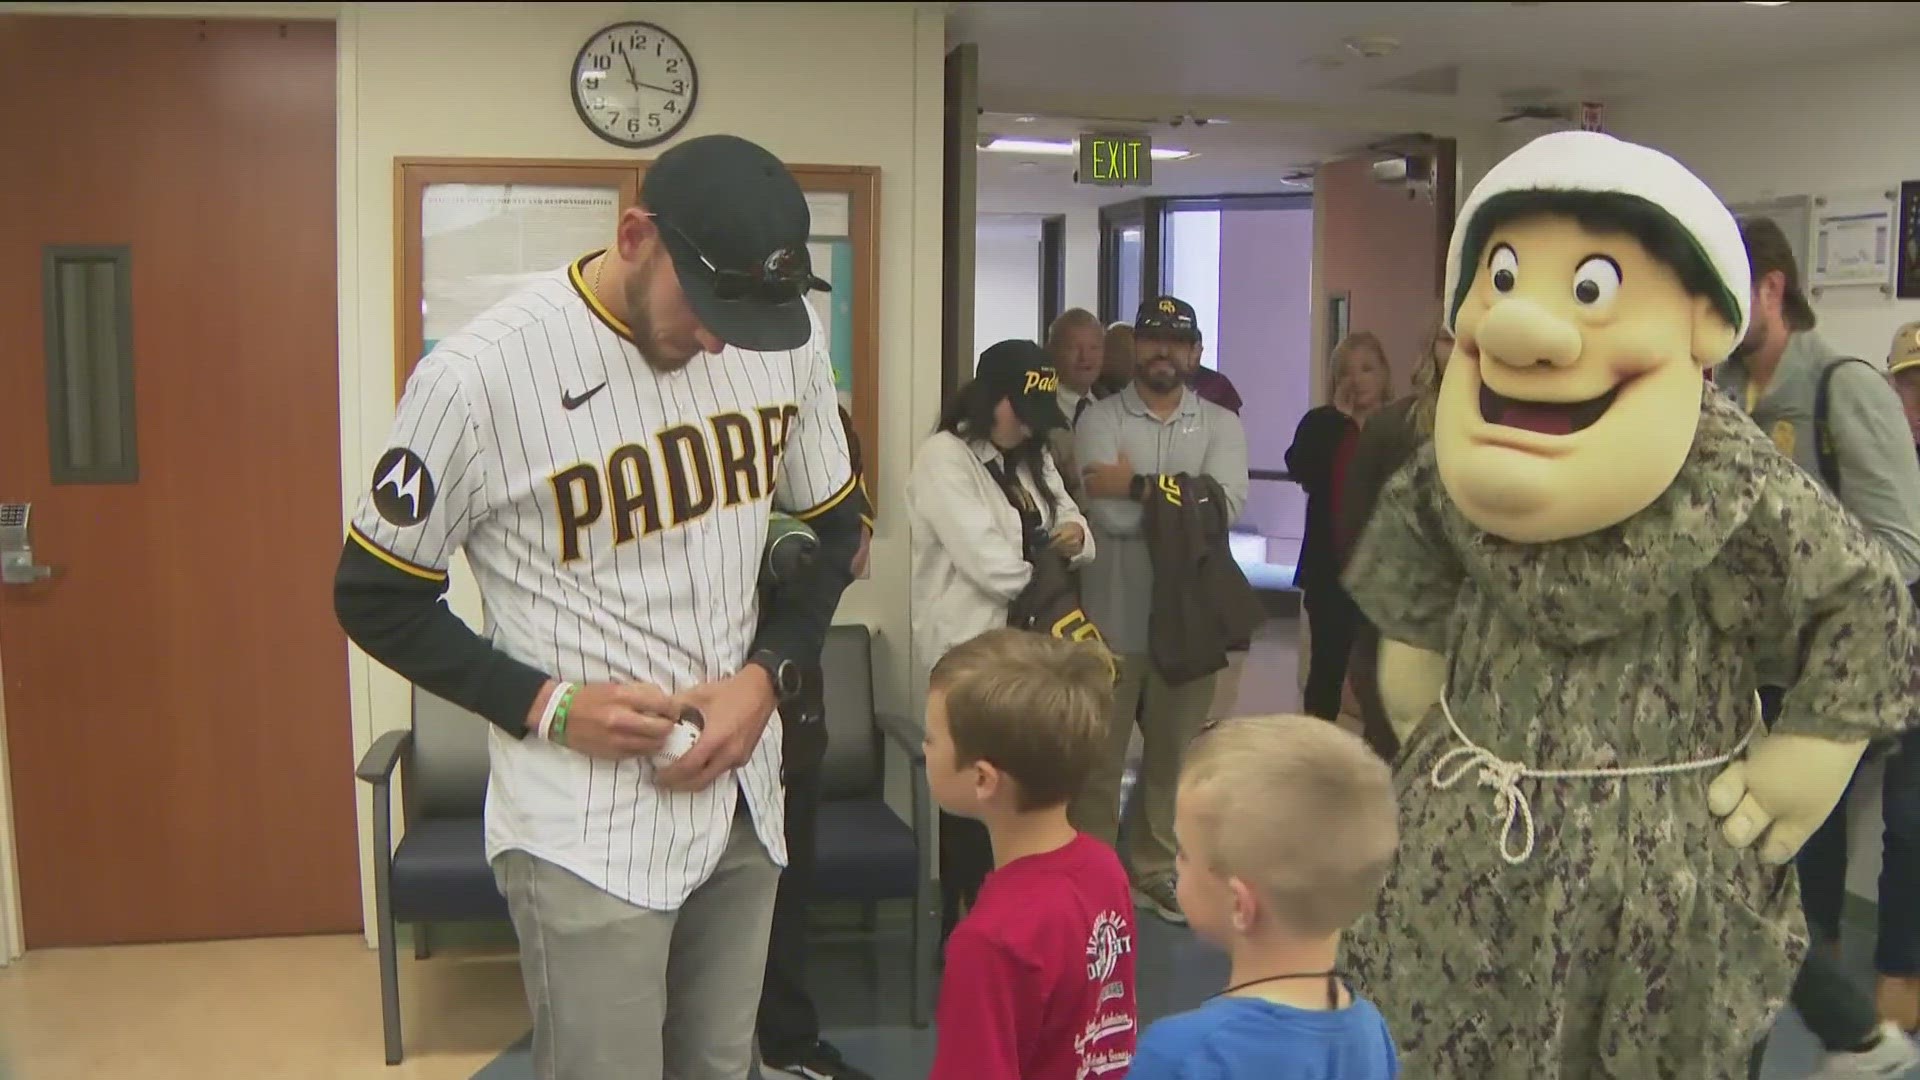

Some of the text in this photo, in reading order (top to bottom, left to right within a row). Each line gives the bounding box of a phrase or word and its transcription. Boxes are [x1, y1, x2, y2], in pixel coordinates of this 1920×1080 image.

[611, 41, 623, 55] 11
[630, 35, 647, 50] 12
[656, 43, 661, 57] 1
[593, 55, 611, 70] 10
[666, 58, 678, 73] 2
[586, 76, 599, 90] 9
[672, 80, 684, 95] 3
[663, 100, 676, 114] 4
[608, 111, 620, 125] 7
[648, 113, 661, 127] 5
[627, 118, 640, 133] 6
[1093, 141, 1141, 178] EXIT
